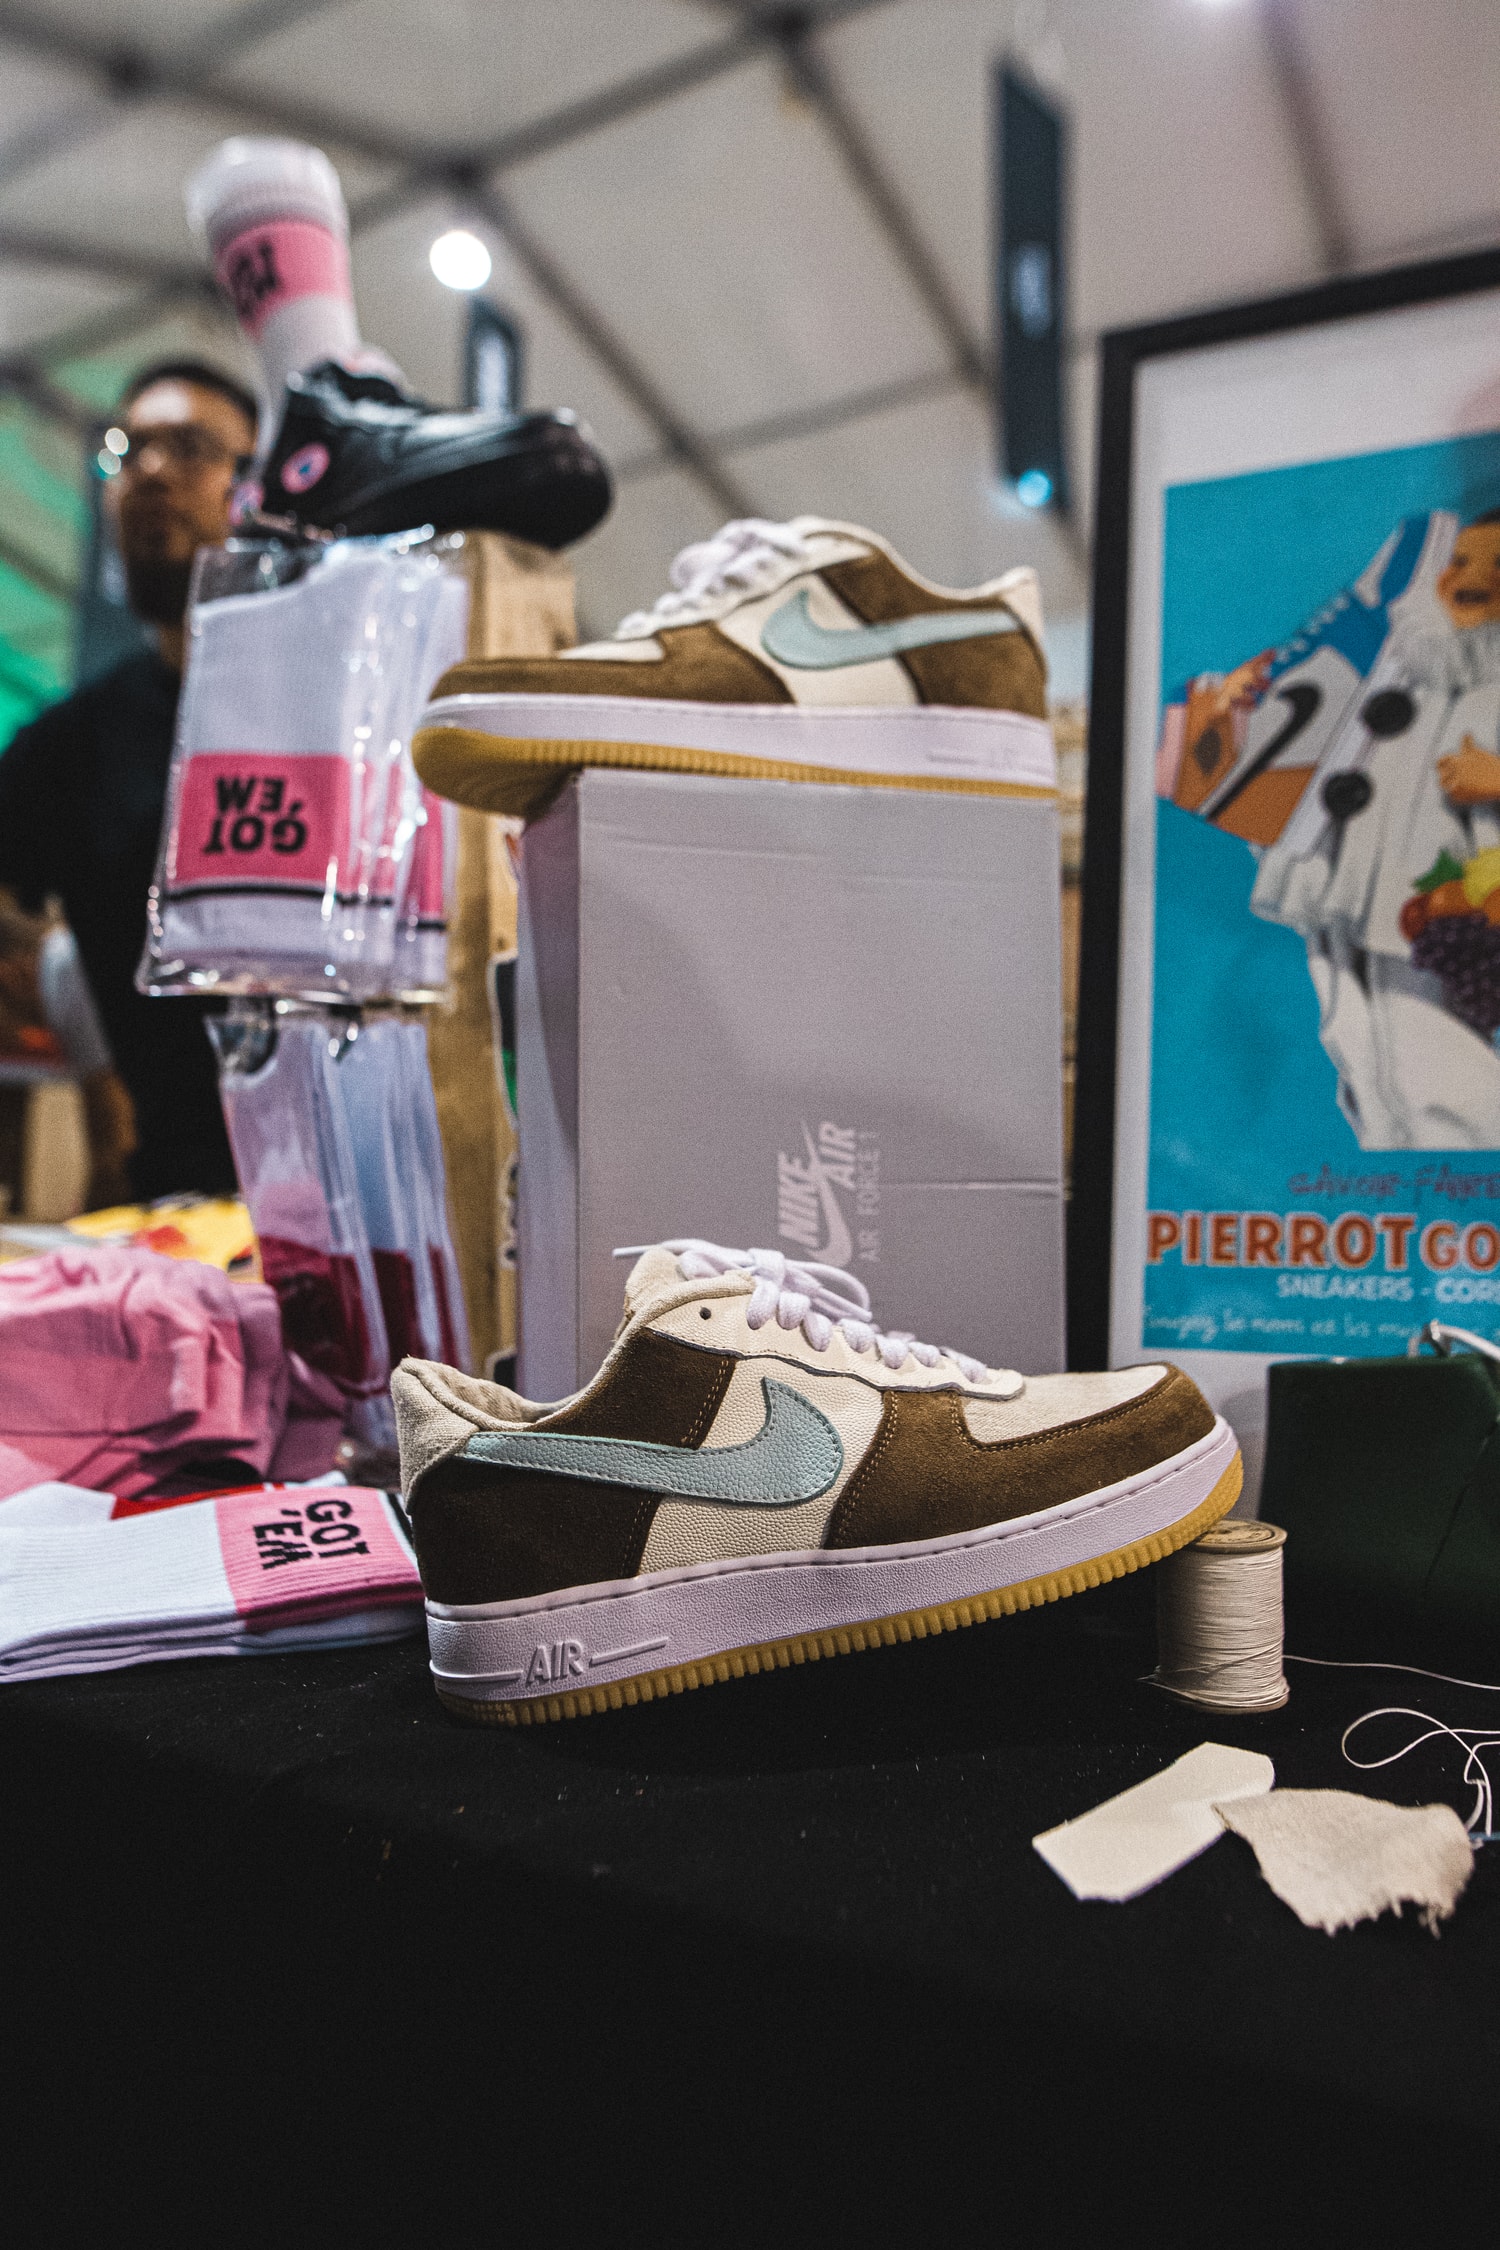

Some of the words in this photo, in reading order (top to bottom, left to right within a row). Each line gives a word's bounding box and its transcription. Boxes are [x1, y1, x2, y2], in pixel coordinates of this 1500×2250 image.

[204, 816, 308, 856] GOT
[817, 1121, 856, 1191] AIR
[777, 1151, 819, 1248] NIKE
[1147, 1210, 1418, 1271] PIERROT
[1277, 1273, 1415, 1301] SNEAKERS
[305, 1500, 371, 1558] GOT
[525, 1640, 584, 1687] AIR
